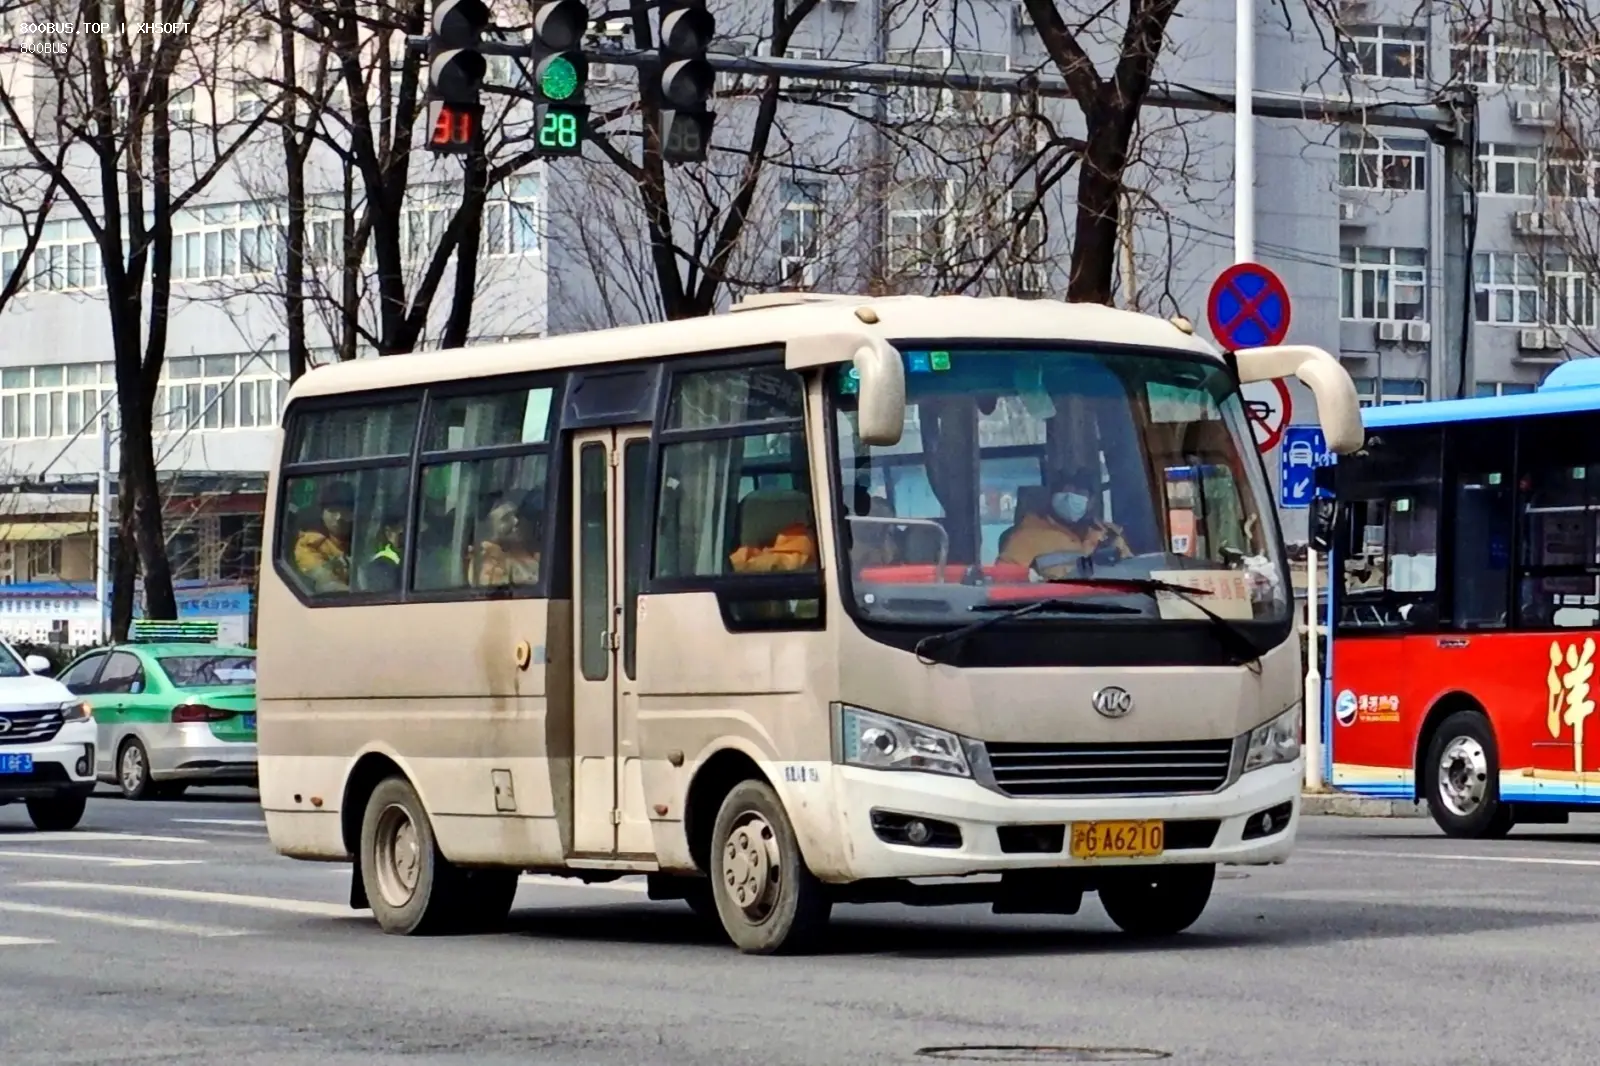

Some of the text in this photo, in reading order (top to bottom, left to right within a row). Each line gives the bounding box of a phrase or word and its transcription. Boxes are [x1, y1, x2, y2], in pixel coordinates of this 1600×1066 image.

[433, 107, 471, 144] 31
[539, 112, 577, 147] 28
[1547, 637, 1596, 773] 洋
